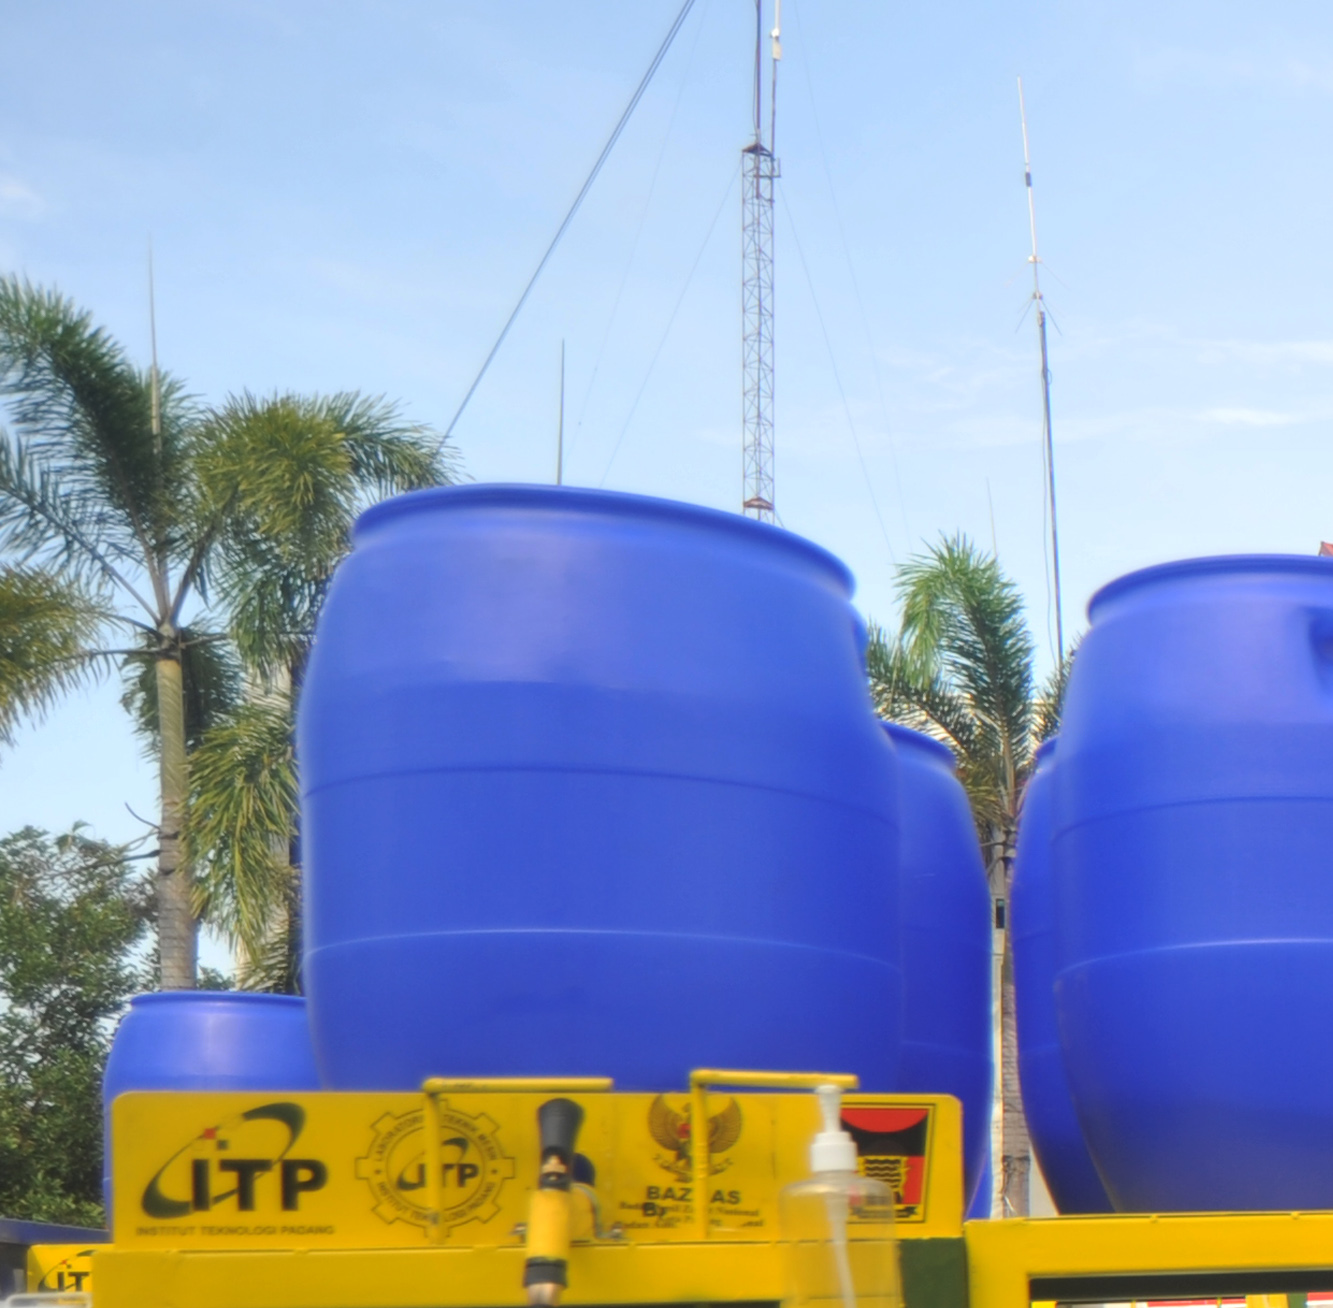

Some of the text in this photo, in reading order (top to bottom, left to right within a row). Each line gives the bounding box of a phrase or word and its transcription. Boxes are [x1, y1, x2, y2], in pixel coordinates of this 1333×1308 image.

[192, 1159, 328, 1211] ITP
[646, 1185, 741, 1205] BAZAS
[201, 1226, 277, 1236] TEKNOLOGI
[281, 1225, 335, 1235] PADANG
[57, 1271, 90, 1292] IT
